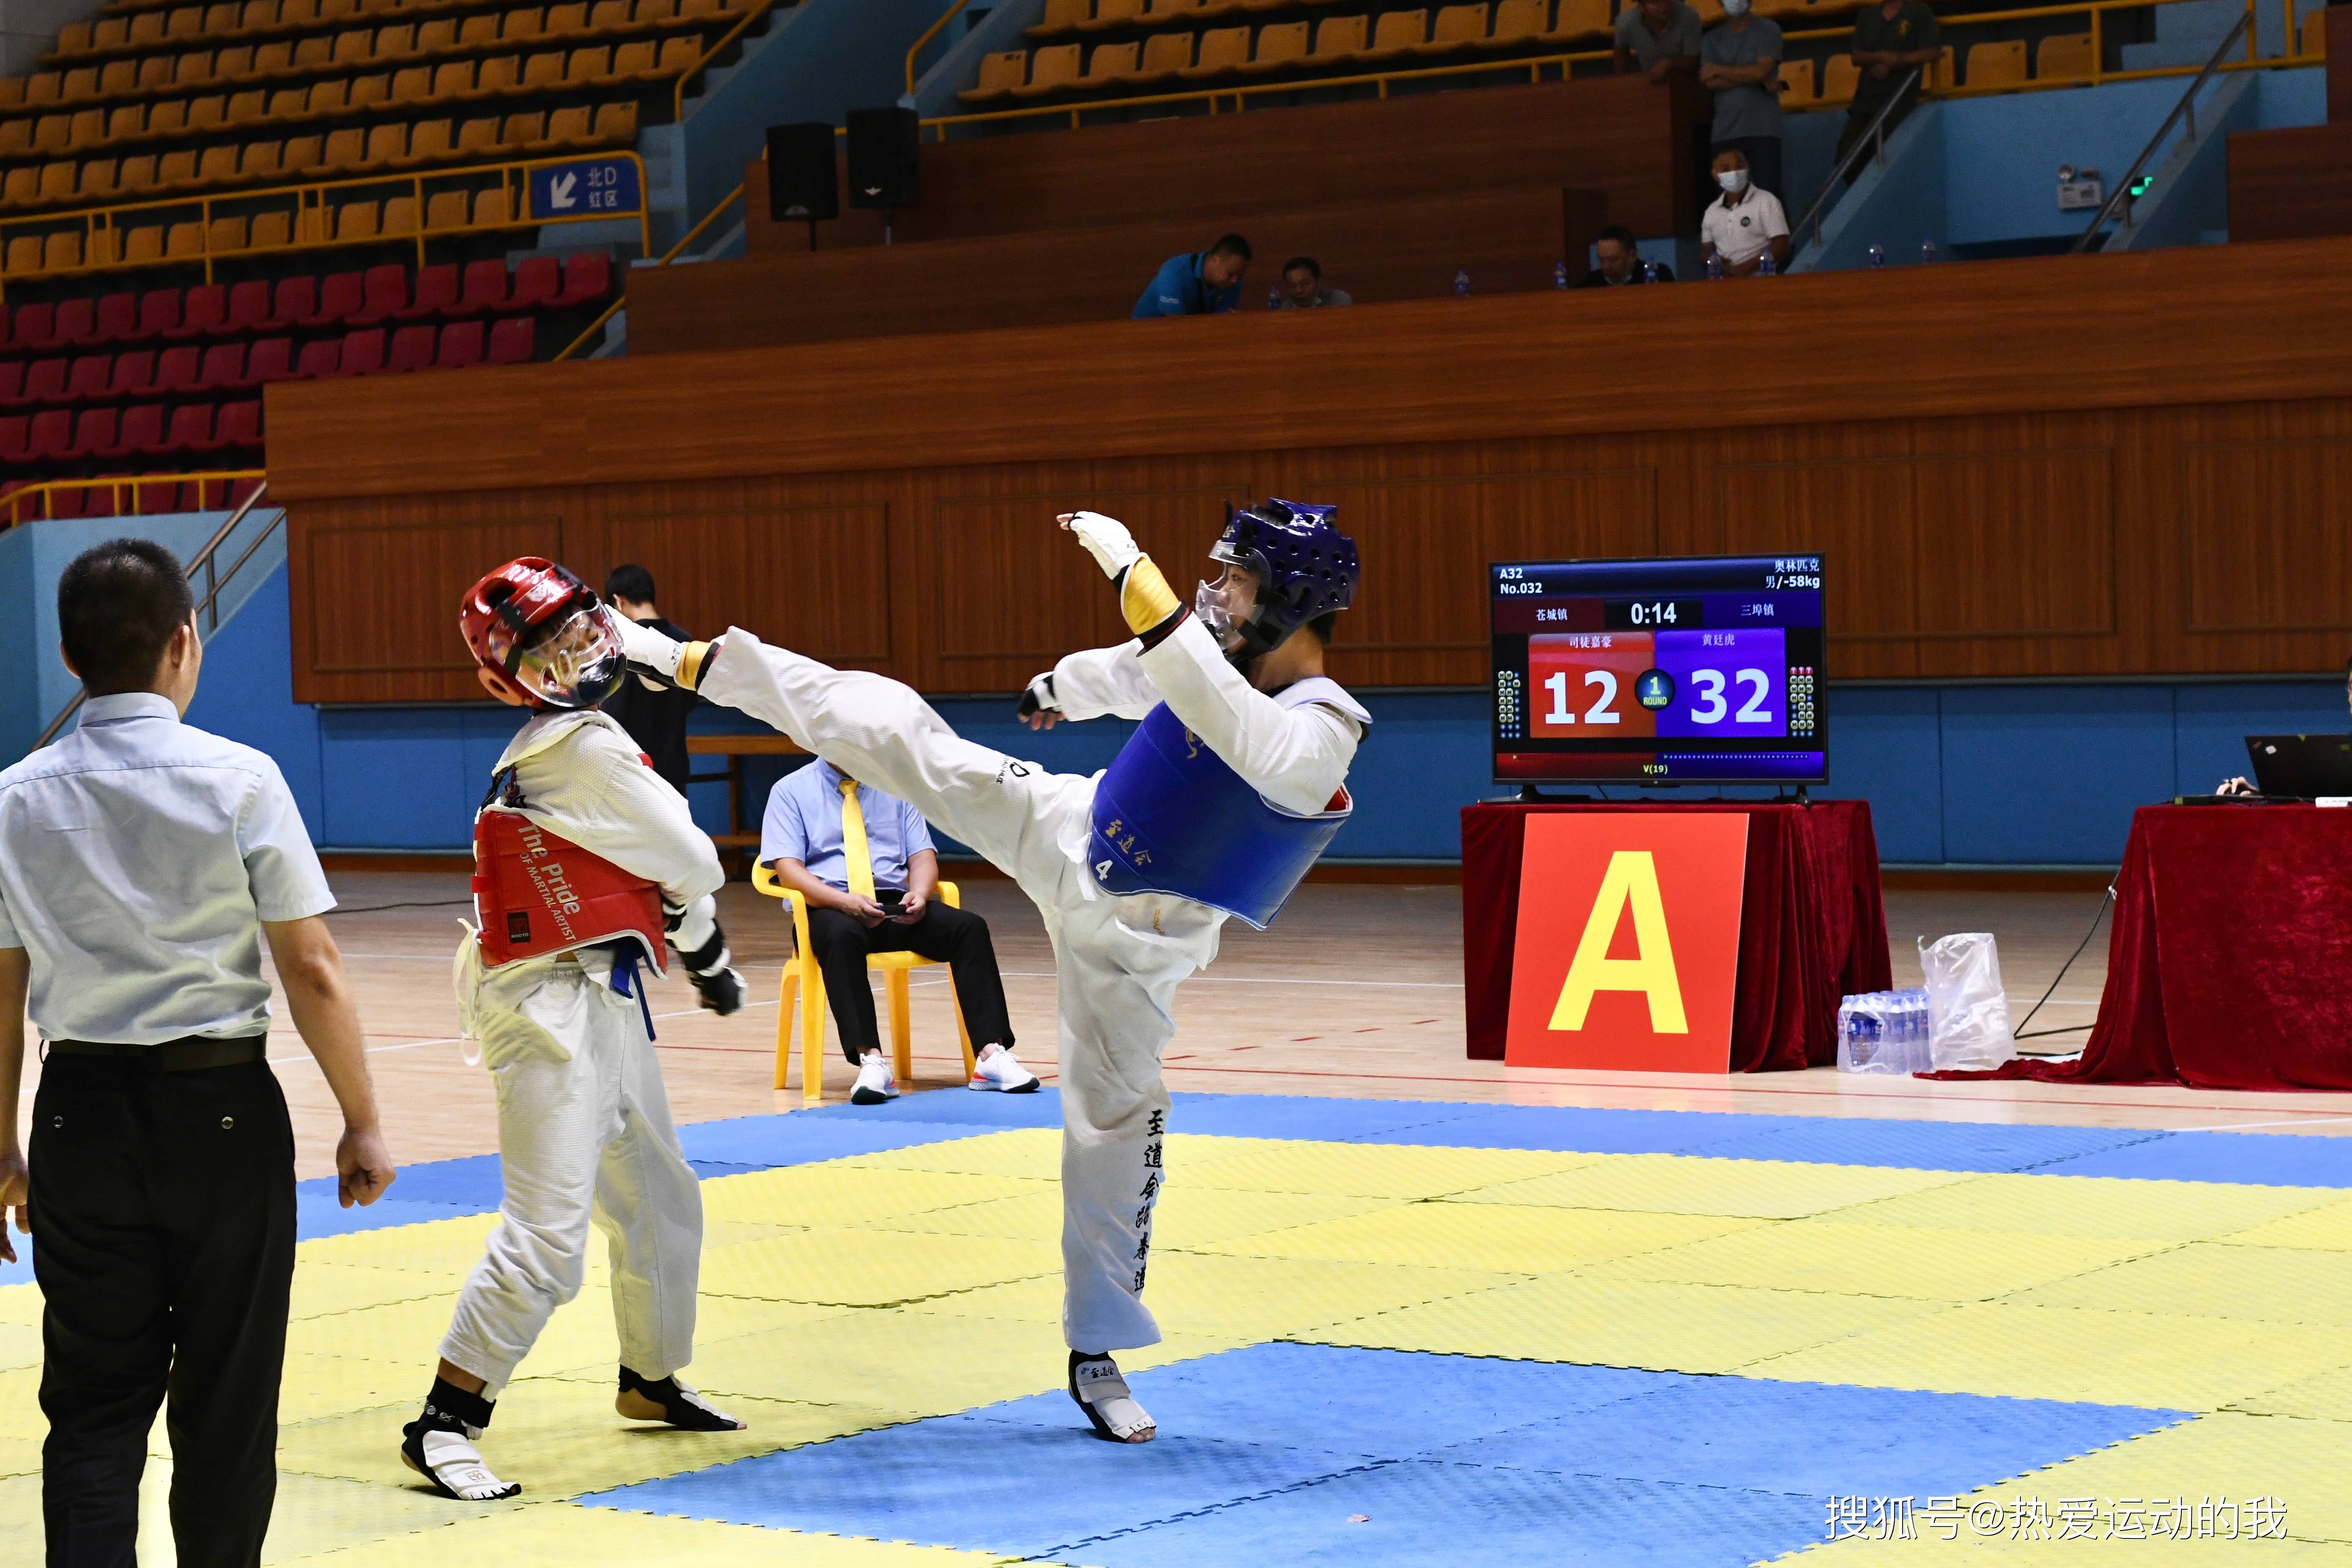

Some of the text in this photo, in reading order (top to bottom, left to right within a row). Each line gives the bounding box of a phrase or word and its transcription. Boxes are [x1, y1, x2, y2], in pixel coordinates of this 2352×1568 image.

[1775, 558, 1820, 573] 奥林匹克
[1500, 568, 1523, 579] A32
[1500, 583, 1543, 594] No.032
[1766, 575, 1820, 590] 男/-58kg
[1536, 608, 1568, 621] 苍城镇
[1631, 602, 1677, 624] 0:14
[1741, 603, 1774, 616] 三埠镇
[1569, 636, 1612, 648] 司徒嘉豪
[1702, 633, 1735, 646] 黄廷虎
[1650, 676, 1661, 695] 1
[1544, 670, 1620, 724] 12
[1643, 696, 1667, 705] ROUND
[1691, 668, 1772, 724] 32
[1643, 765, 1668, 774] V(19)
[518, 822, 580, 915] The Pride
[1095, 859, 1113, 881] 4
[520, 852, 533, 864] OF
[527, 866, 556, 908] MARTIAL
[551, 909, 576, 941] ARTIST
[1547, 851, 1688, 1034] A
